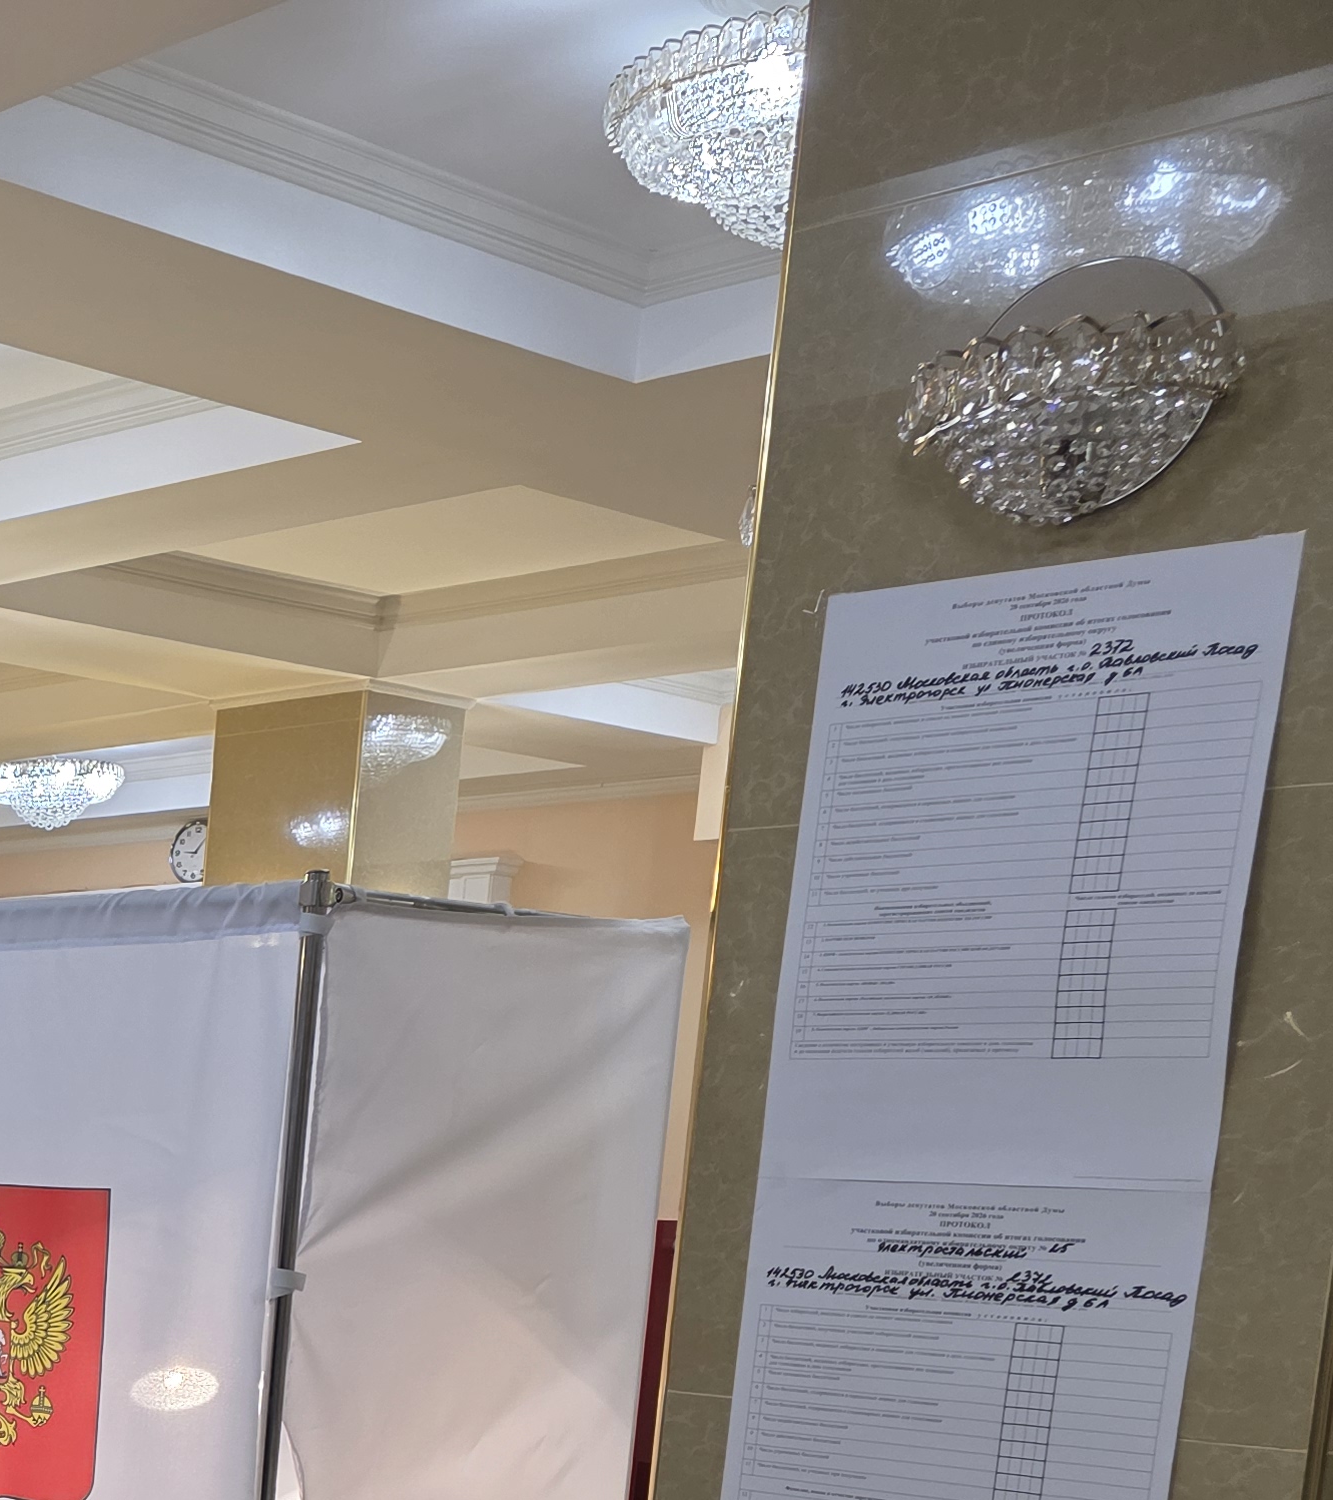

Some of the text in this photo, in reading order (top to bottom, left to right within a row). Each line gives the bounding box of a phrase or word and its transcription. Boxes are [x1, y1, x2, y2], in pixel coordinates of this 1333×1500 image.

[1019, 608, 1073, 622] ПРОТОКОЛ
[1089, 638, 1135, 657] 2372
[939, 1220, 991, 1230] ПРОТОКОЛ
